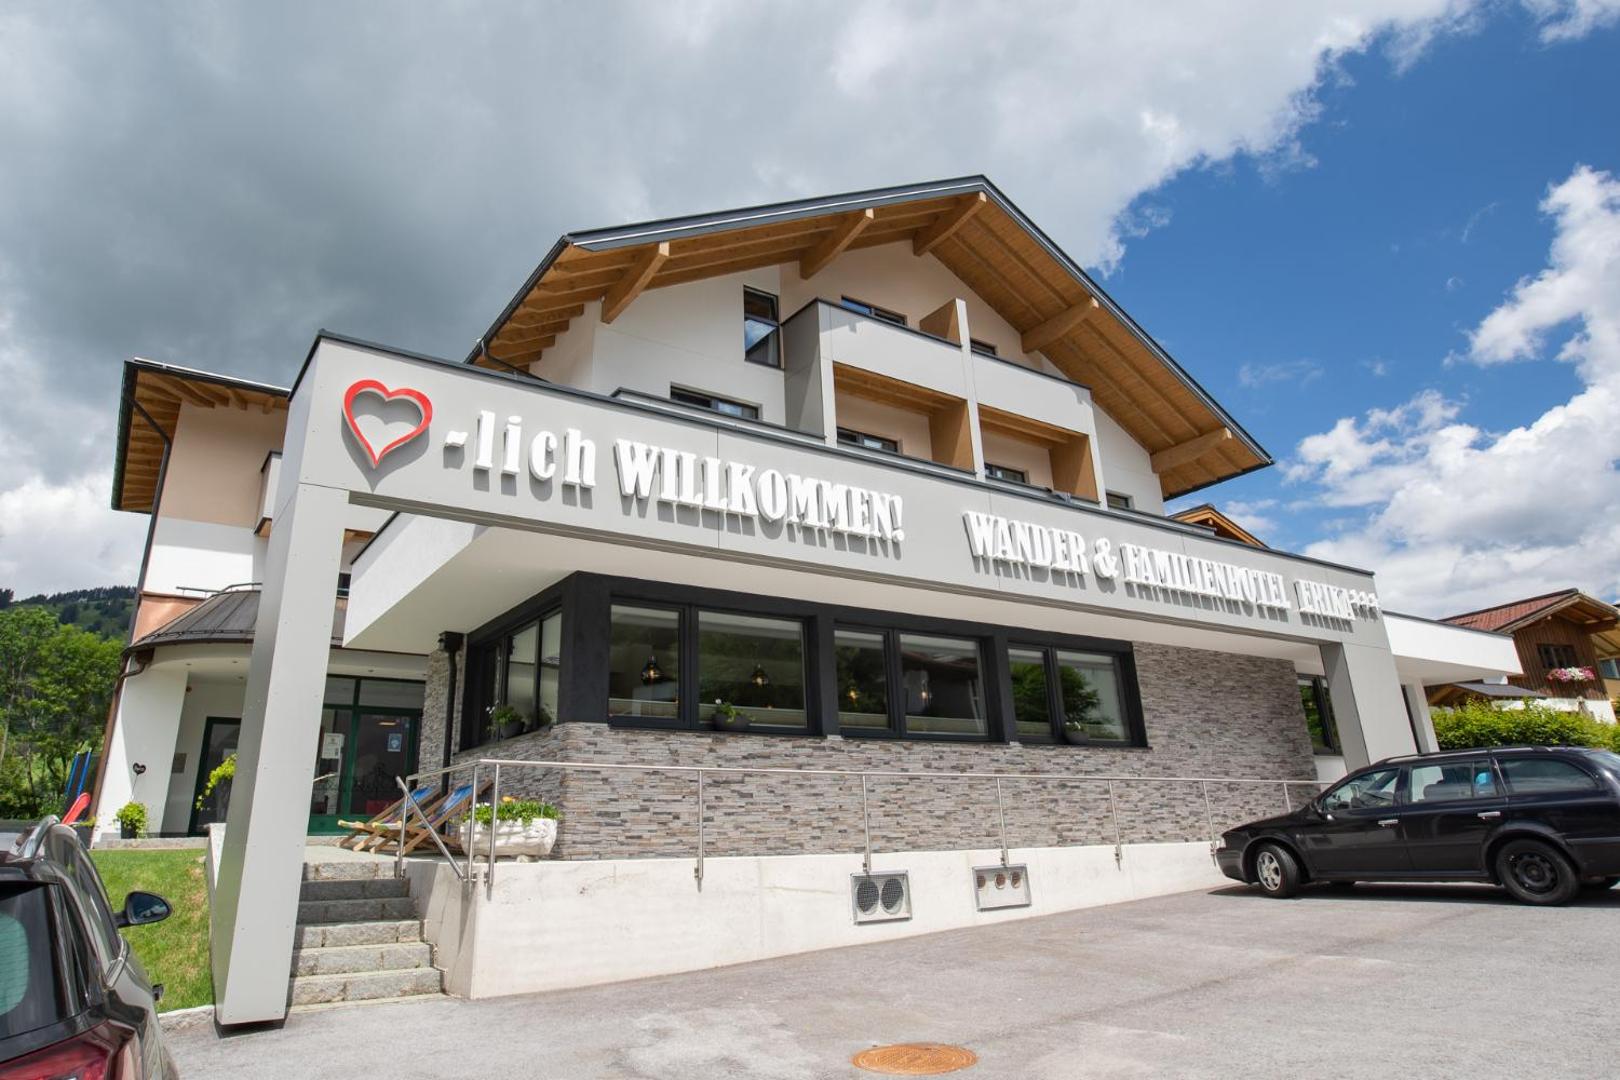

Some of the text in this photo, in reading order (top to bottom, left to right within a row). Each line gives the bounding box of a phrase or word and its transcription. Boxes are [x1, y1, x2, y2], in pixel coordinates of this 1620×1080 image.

[615, 438, 905, 542] WILLKOMMEN!
[962, 512, 1089, 574] WANDER
[1093, 537, 1119, 579] &
[1120, 543, 1291, 609] FAMILIENHOTEL
